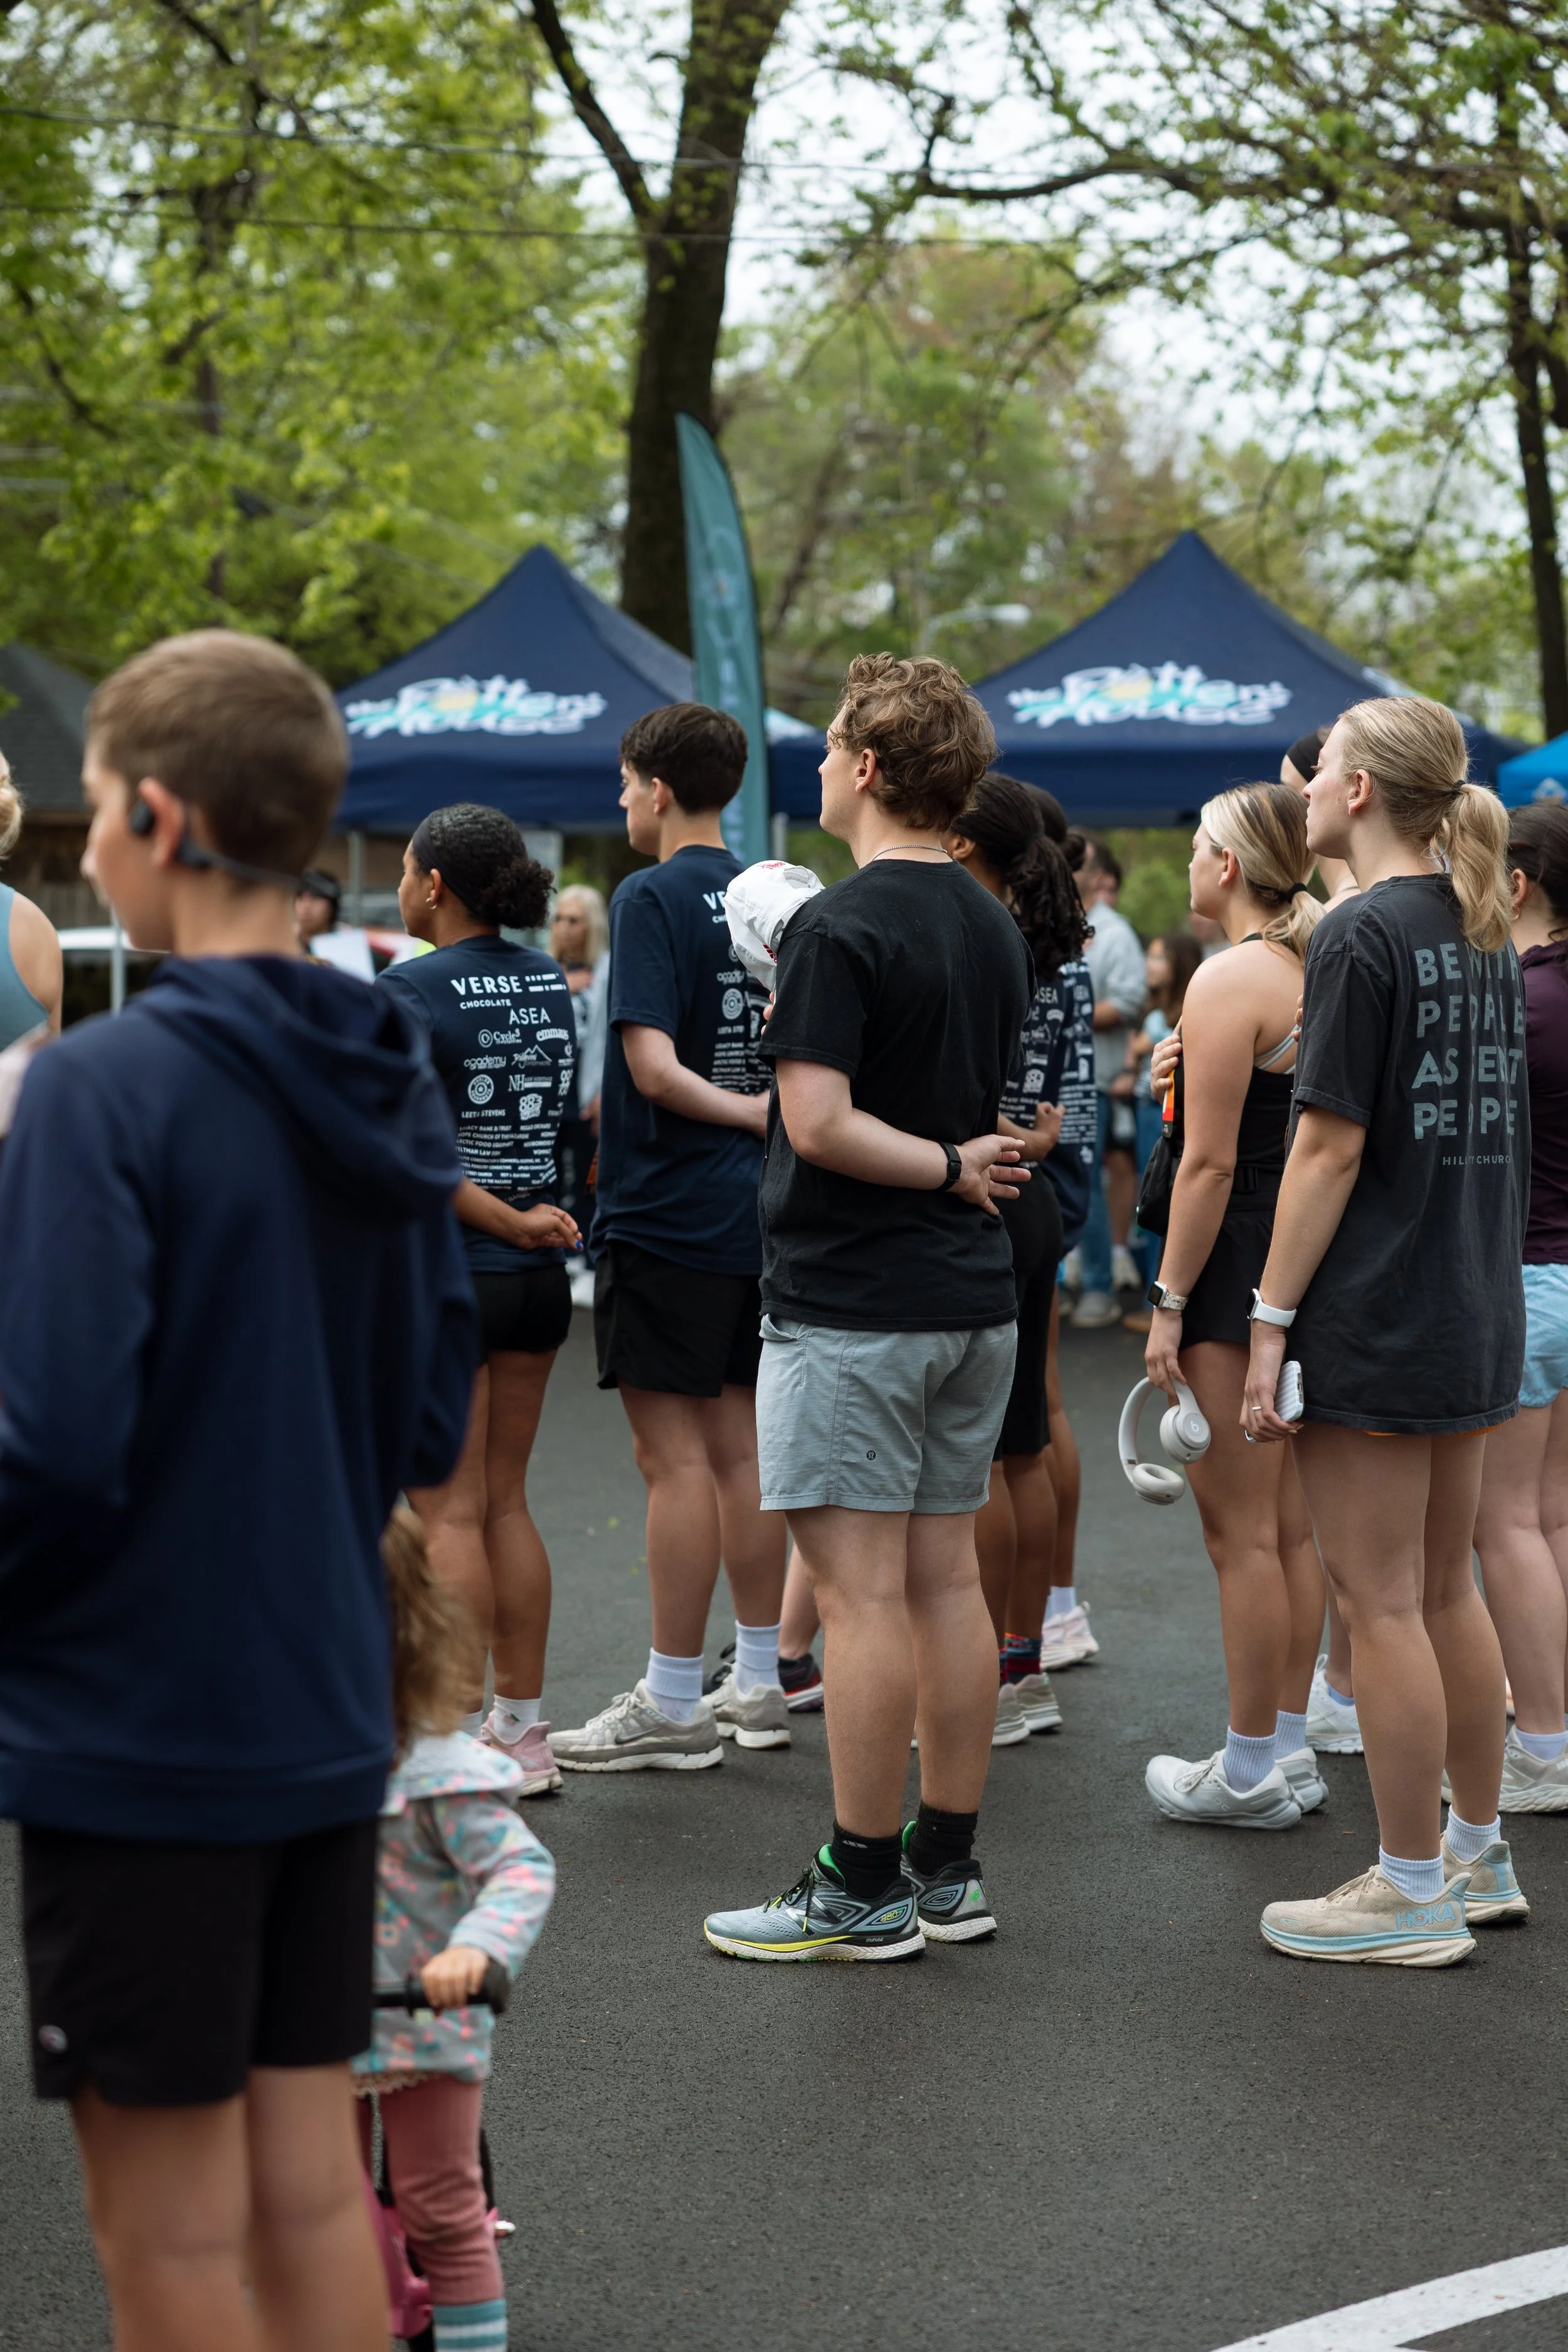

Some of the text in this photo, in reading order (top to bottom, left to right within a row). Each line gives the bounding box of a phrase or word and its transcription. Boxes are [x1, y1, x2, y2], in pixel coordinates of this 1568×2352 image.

[1415, 943, 1462, 987] BE
[450, 975, 523, 995] VERSE
[460, 999, 512, 1009] CHOCOLATE
[509, 1007, 551, 1025] ASEA
[1412, 1046, 1523, 1089] AS ENT
[508, 1074, 526, 1091] NH
[1476, 1155, 1511, 1164] CHURC
[1396, 1902, 1456, 1931] HOKA
